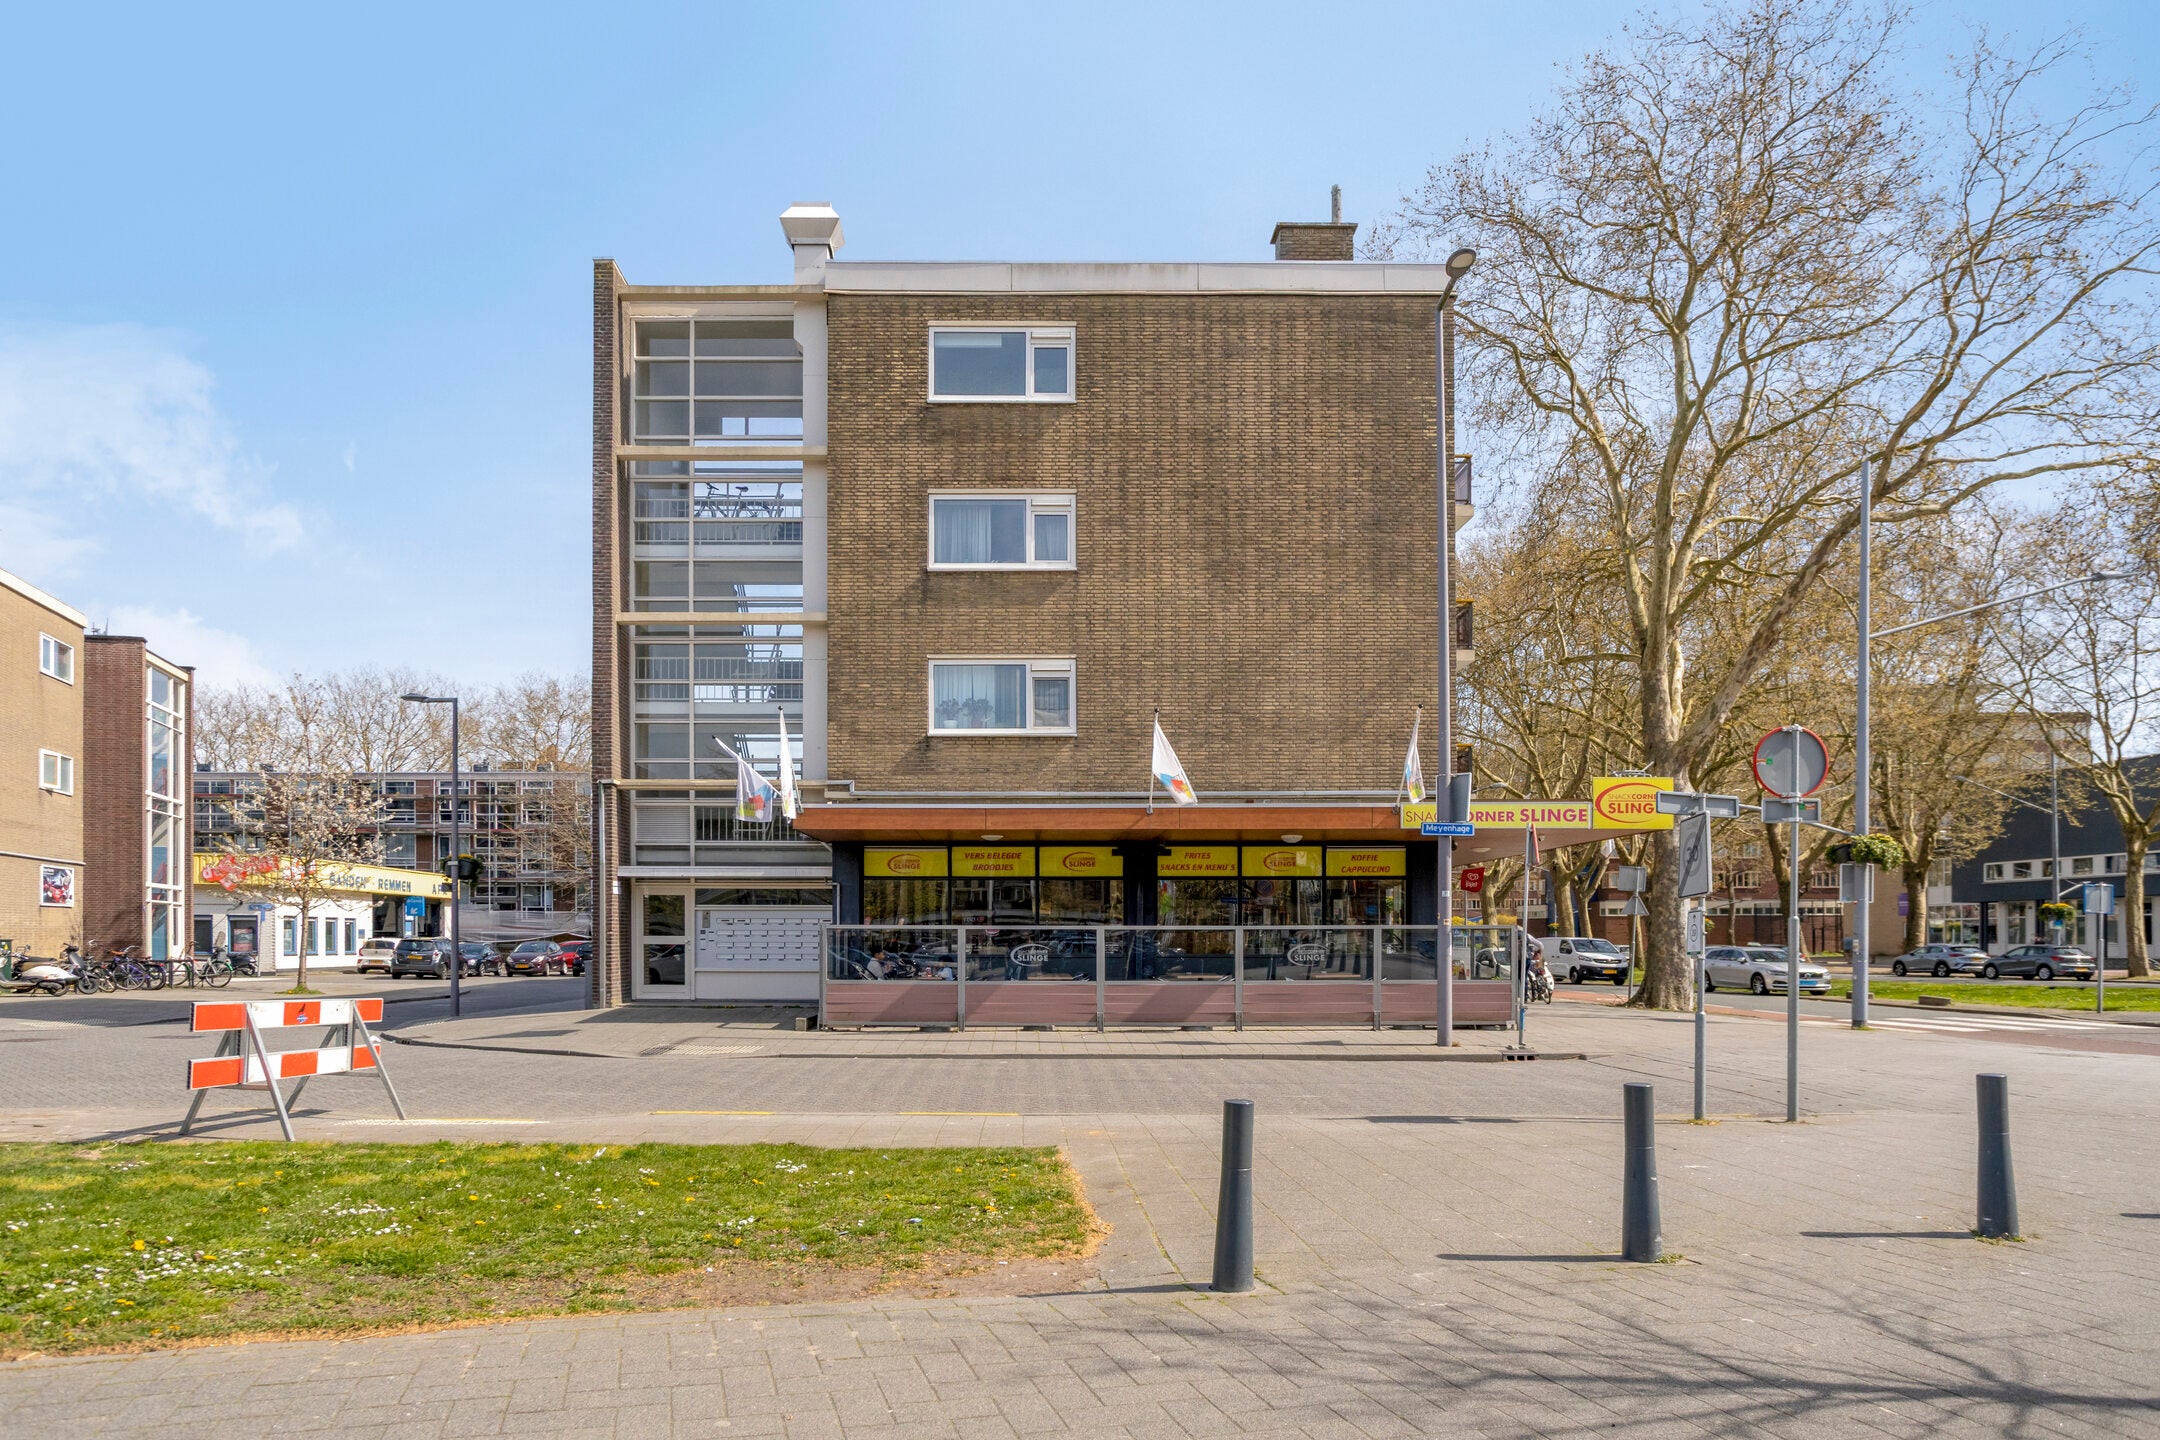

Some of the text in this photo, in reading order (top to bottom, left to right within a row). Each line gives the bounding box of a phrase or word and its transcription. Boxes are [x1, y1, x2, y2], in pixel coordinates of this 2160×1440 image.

[1608, 803, 1655, 814] SLING
[1519, 808, 1588, 823] SLINGE
[1425, 824, 1471, 834] Meyenhage
[1160, 863, 1191, 871] SNACKS
[1192, 863, 1203, 871] EN
[1341, 865, 1391, 873] CAPPUCCINO
[378, 878, 411, 893] REMMEN
[1017, 954, 1049, 962] SLINGE
[1294, 954, 1326, 962] SLINGE
